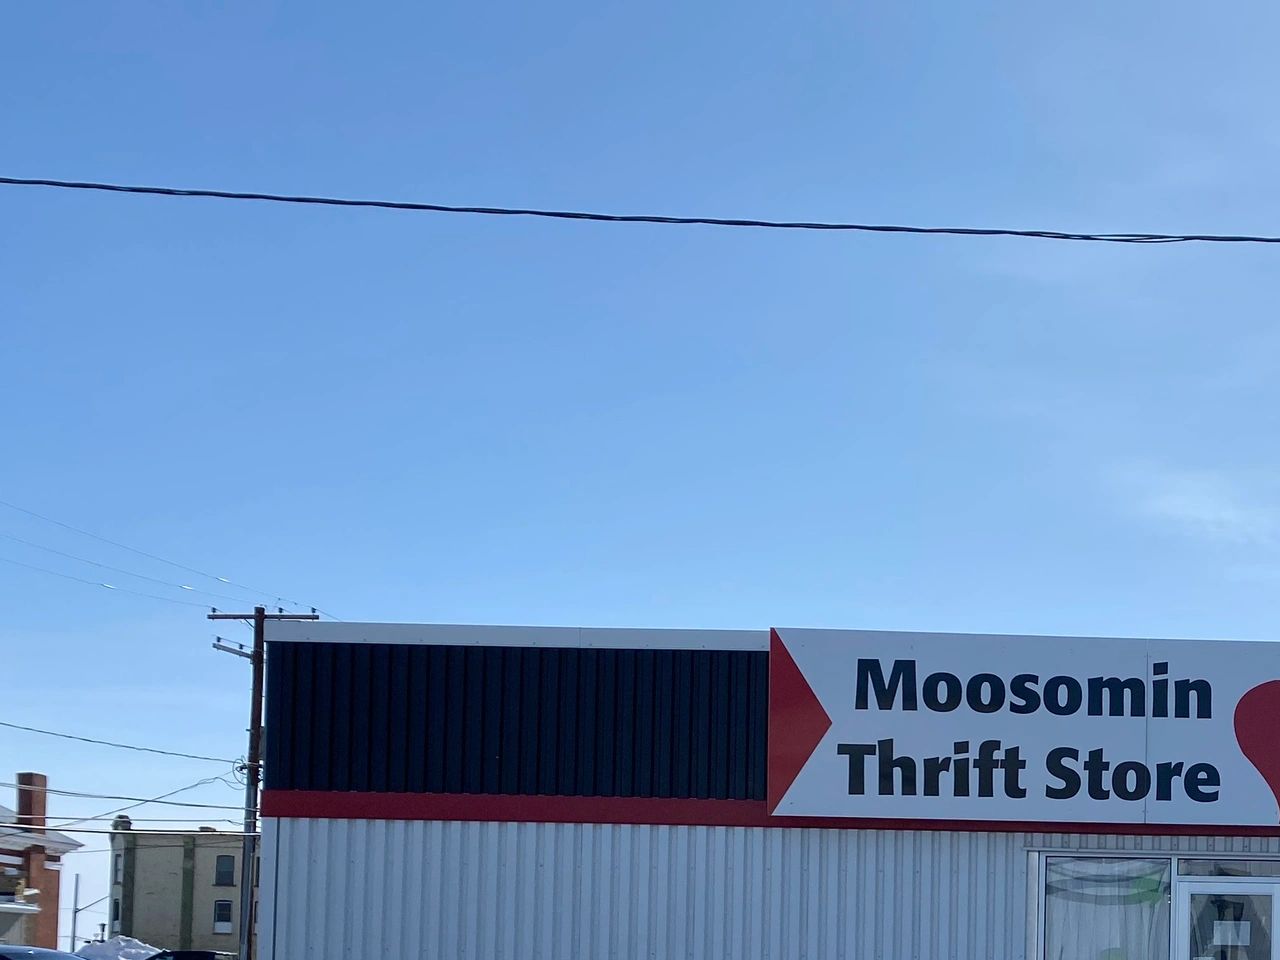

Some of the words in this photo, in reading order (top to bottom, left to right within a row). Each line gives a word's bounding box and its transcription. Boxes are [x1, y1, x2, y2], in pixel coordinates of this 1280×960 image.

[853, 657, 1213, 720] Moosomin
[835, 737, 1028, 800] Thrift
[1044, 745, 1222, 804] Store
